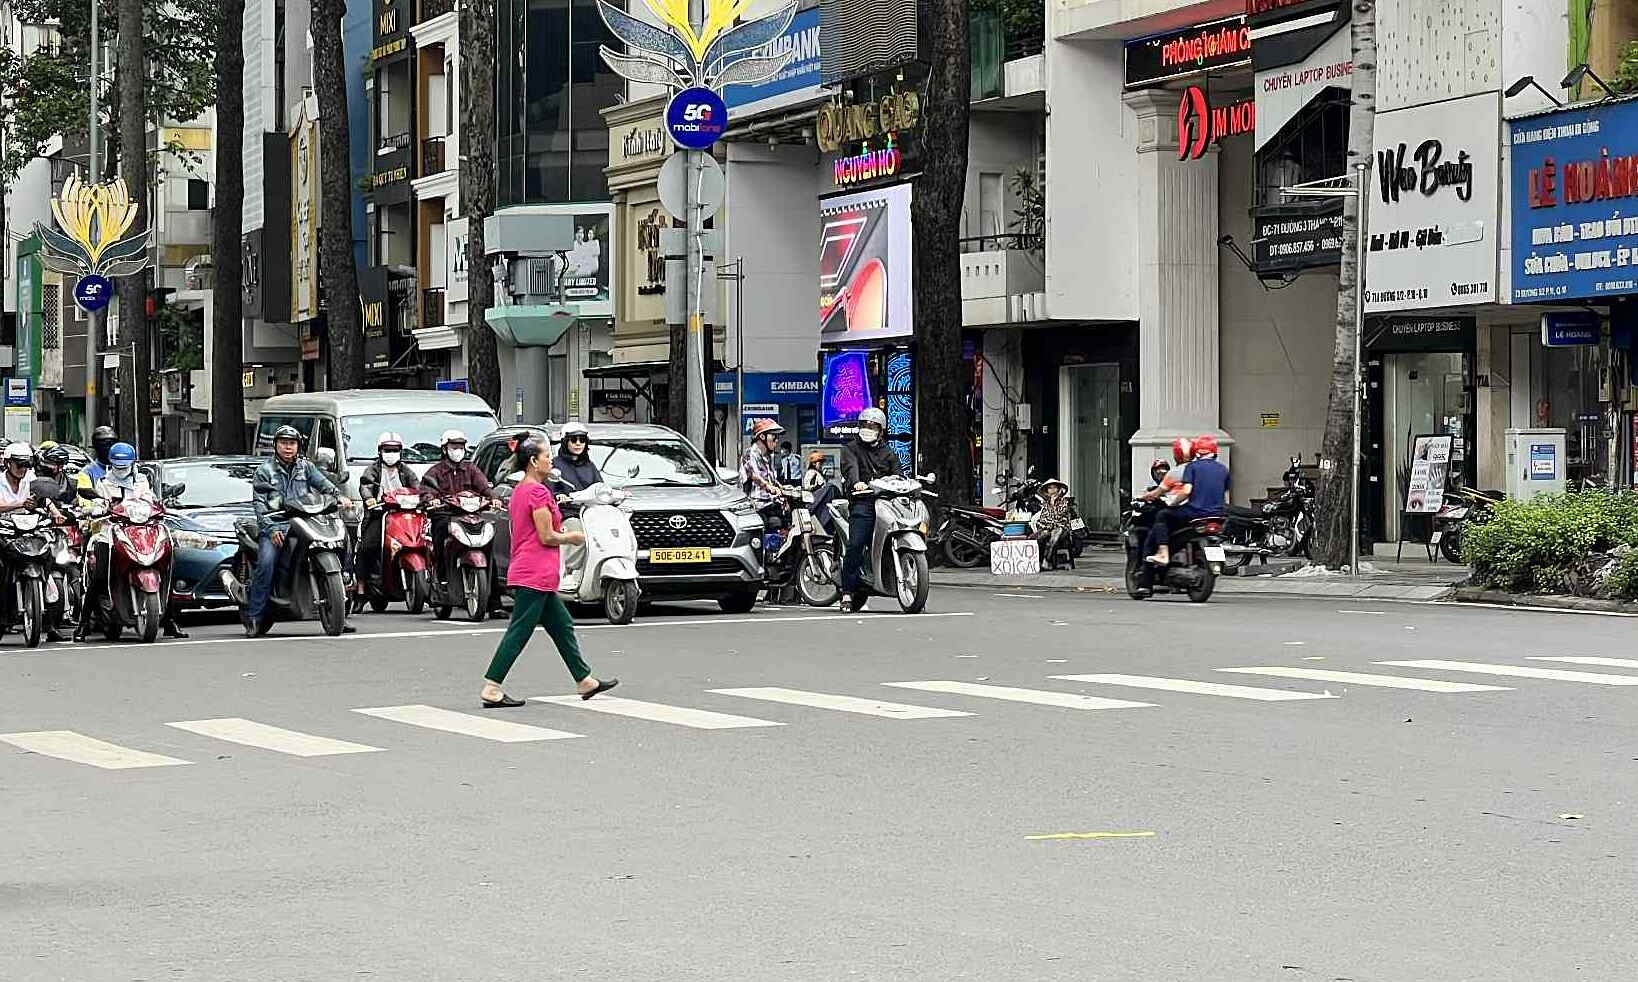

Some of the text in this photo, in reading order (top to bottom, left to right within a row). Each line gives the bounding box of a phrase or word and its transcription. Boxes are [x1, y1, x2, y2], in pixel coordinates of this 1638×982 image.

[380, 8, 396, 36] MIXI
[1263, 72, 1292, 92] CHUYÊN
[1294, 67, 1324, 87] LAPTOP
[683, 104, 713, 121] 5G
[673, 122, 721, 133] mobifone
[1413, 139, 1473, 203] Beauty
[365, 301, 383, 328] MIXI
